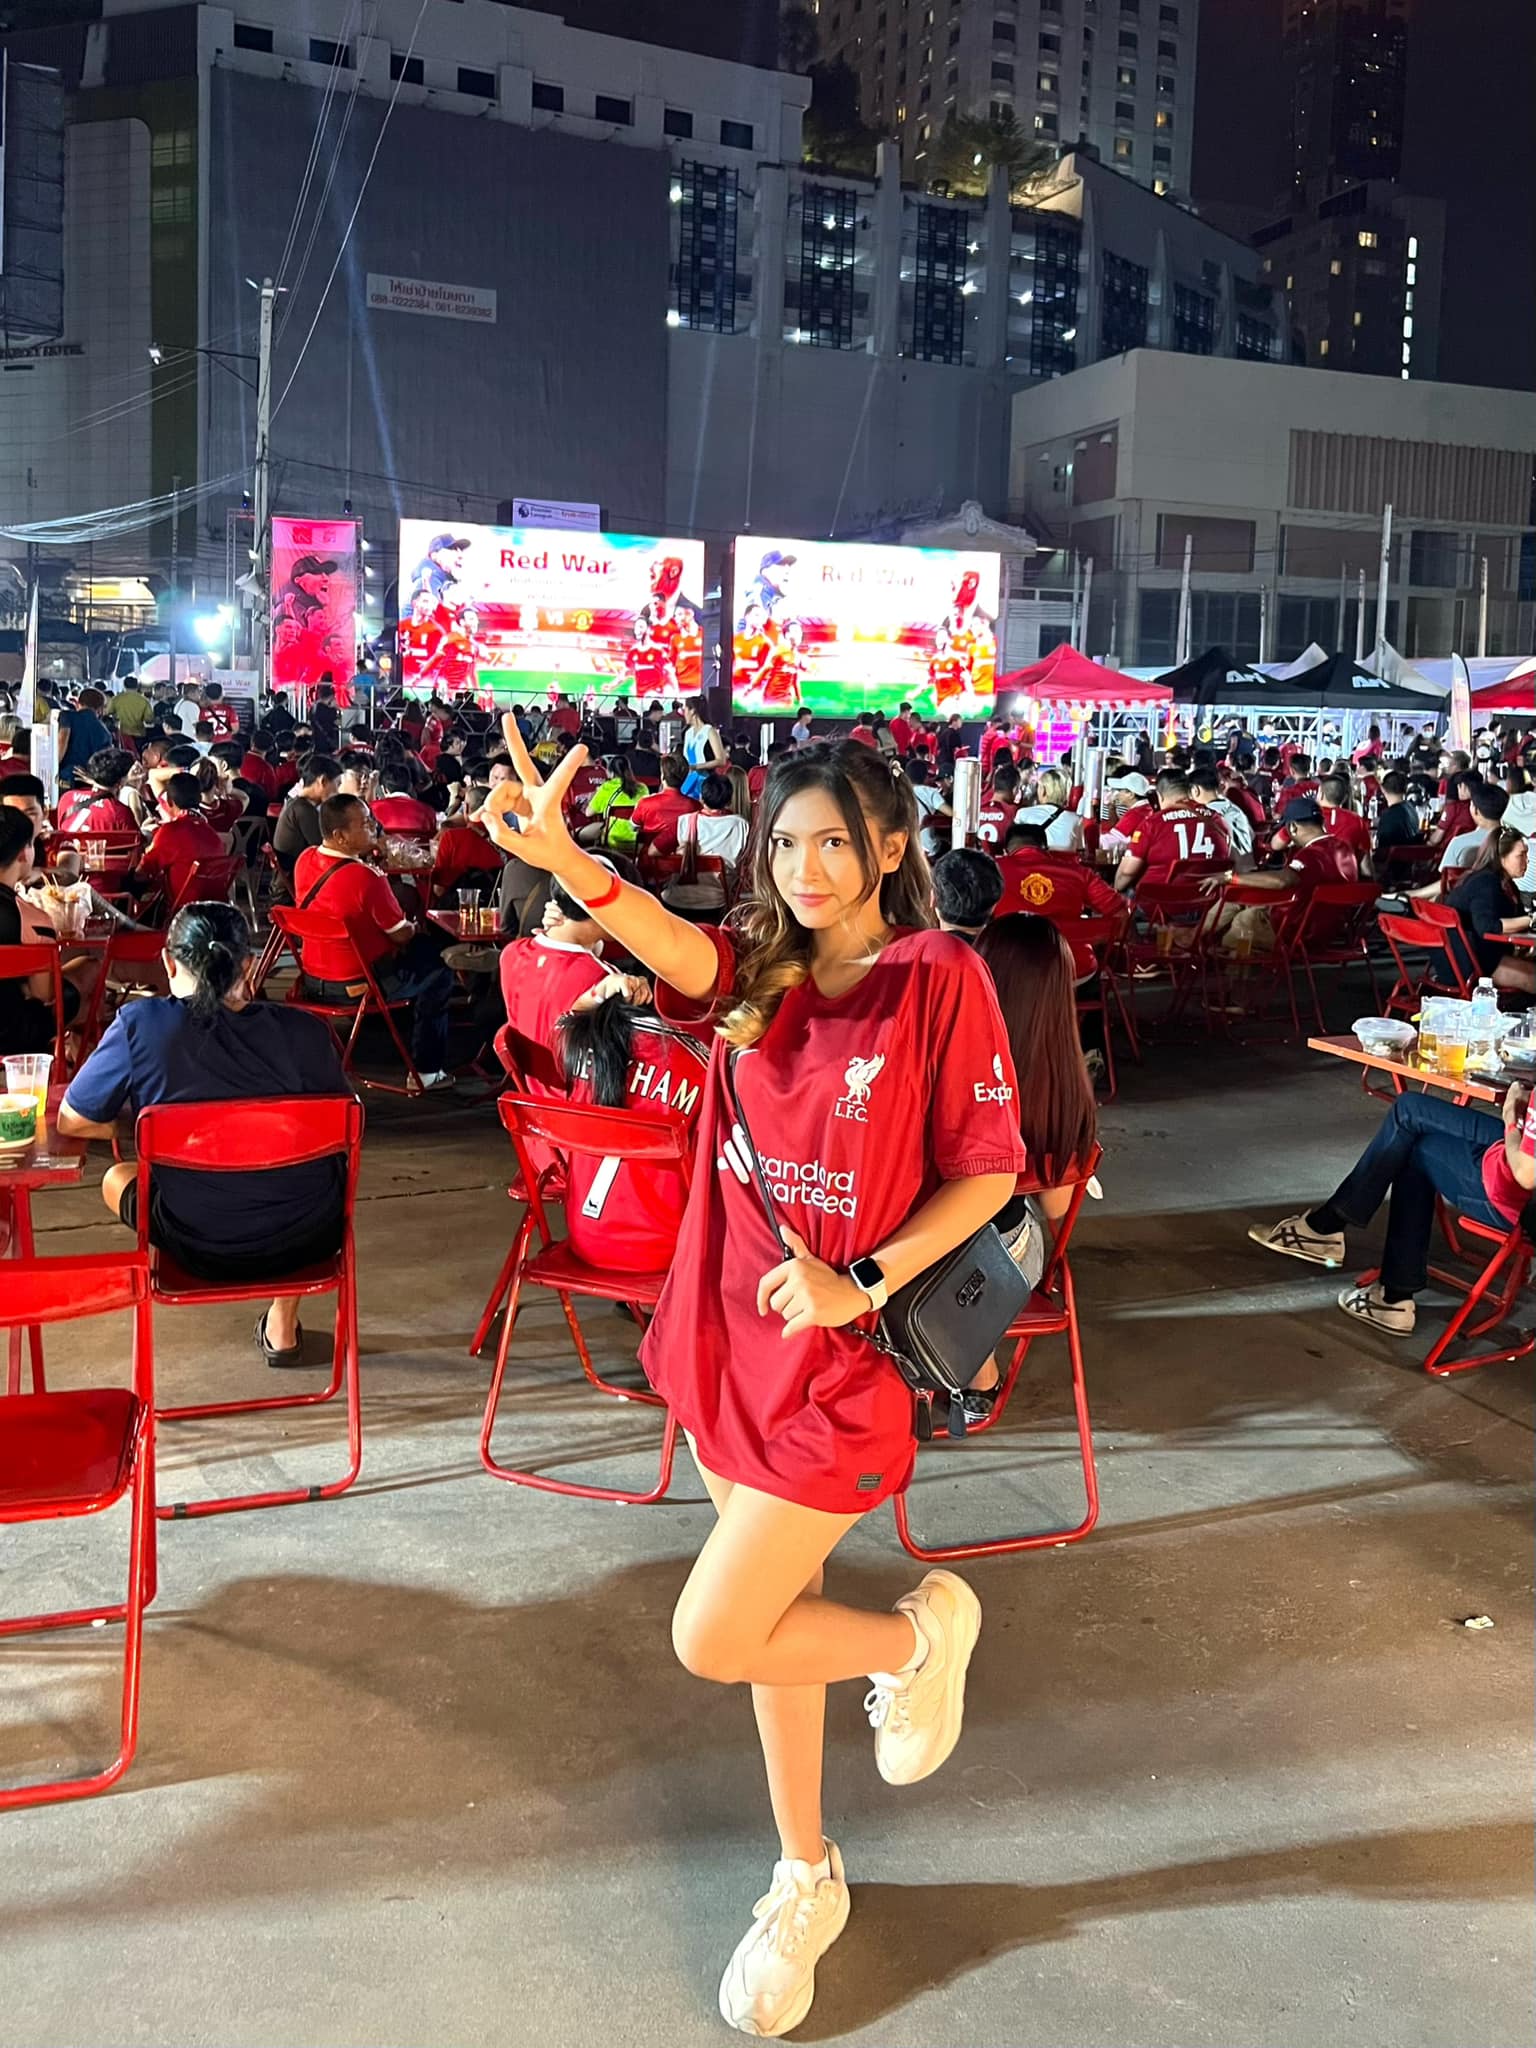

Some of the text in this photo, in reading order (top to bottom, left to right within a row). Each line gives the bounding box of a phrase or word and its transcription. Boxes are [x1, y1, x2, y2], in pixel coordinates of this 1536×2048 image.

[500, 549, 612, 575] Red War
[1173, 822, 1215, 860] 14
[757, 1149, 855, 1193] tandard
